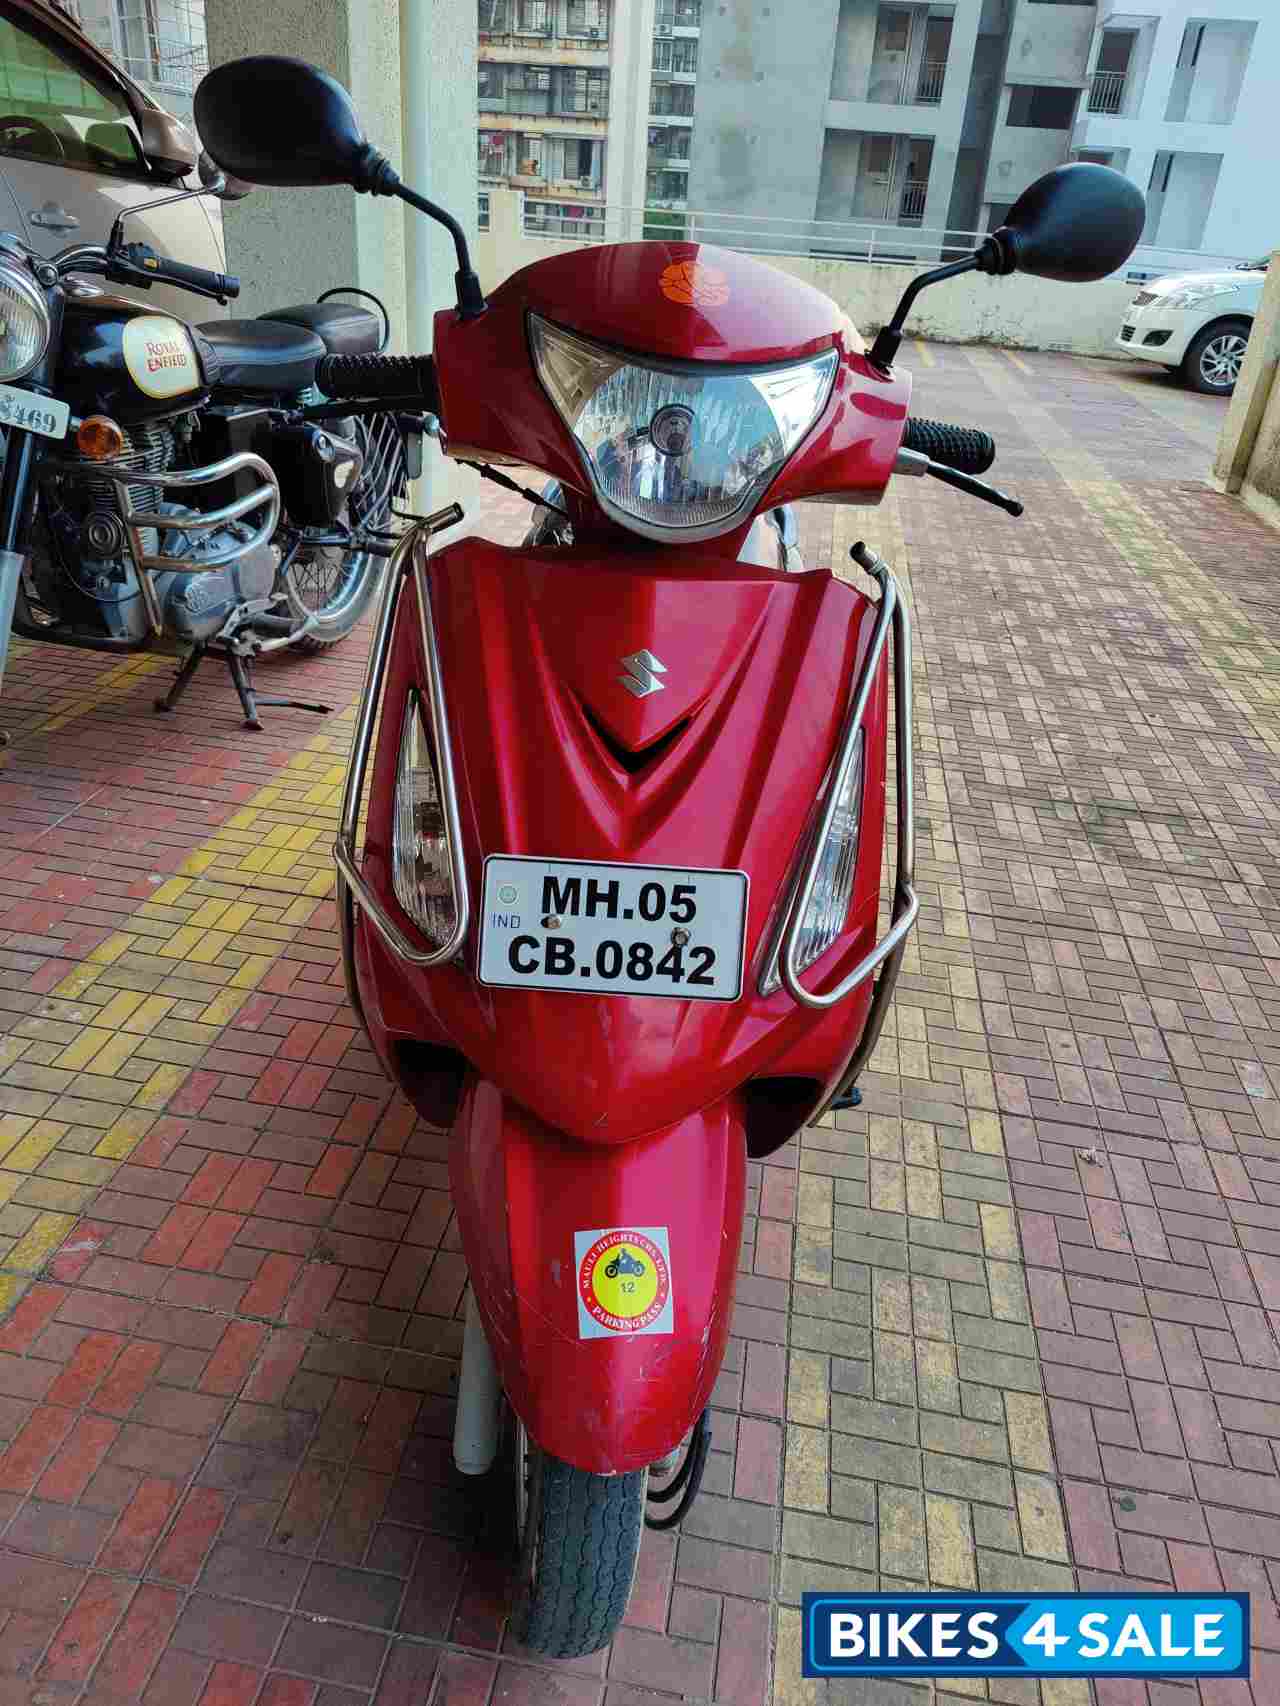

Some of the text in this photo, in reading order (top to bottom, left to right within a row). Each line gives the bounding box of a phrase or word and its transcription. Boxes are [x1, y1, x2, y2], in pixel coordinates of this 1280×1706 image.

[541, 875, 697, 924] MH.05
[492, 912, 521, 929] IND
[508, 934, 716, 985] CB.0842
[621, 1282, 636, 1293] 12
